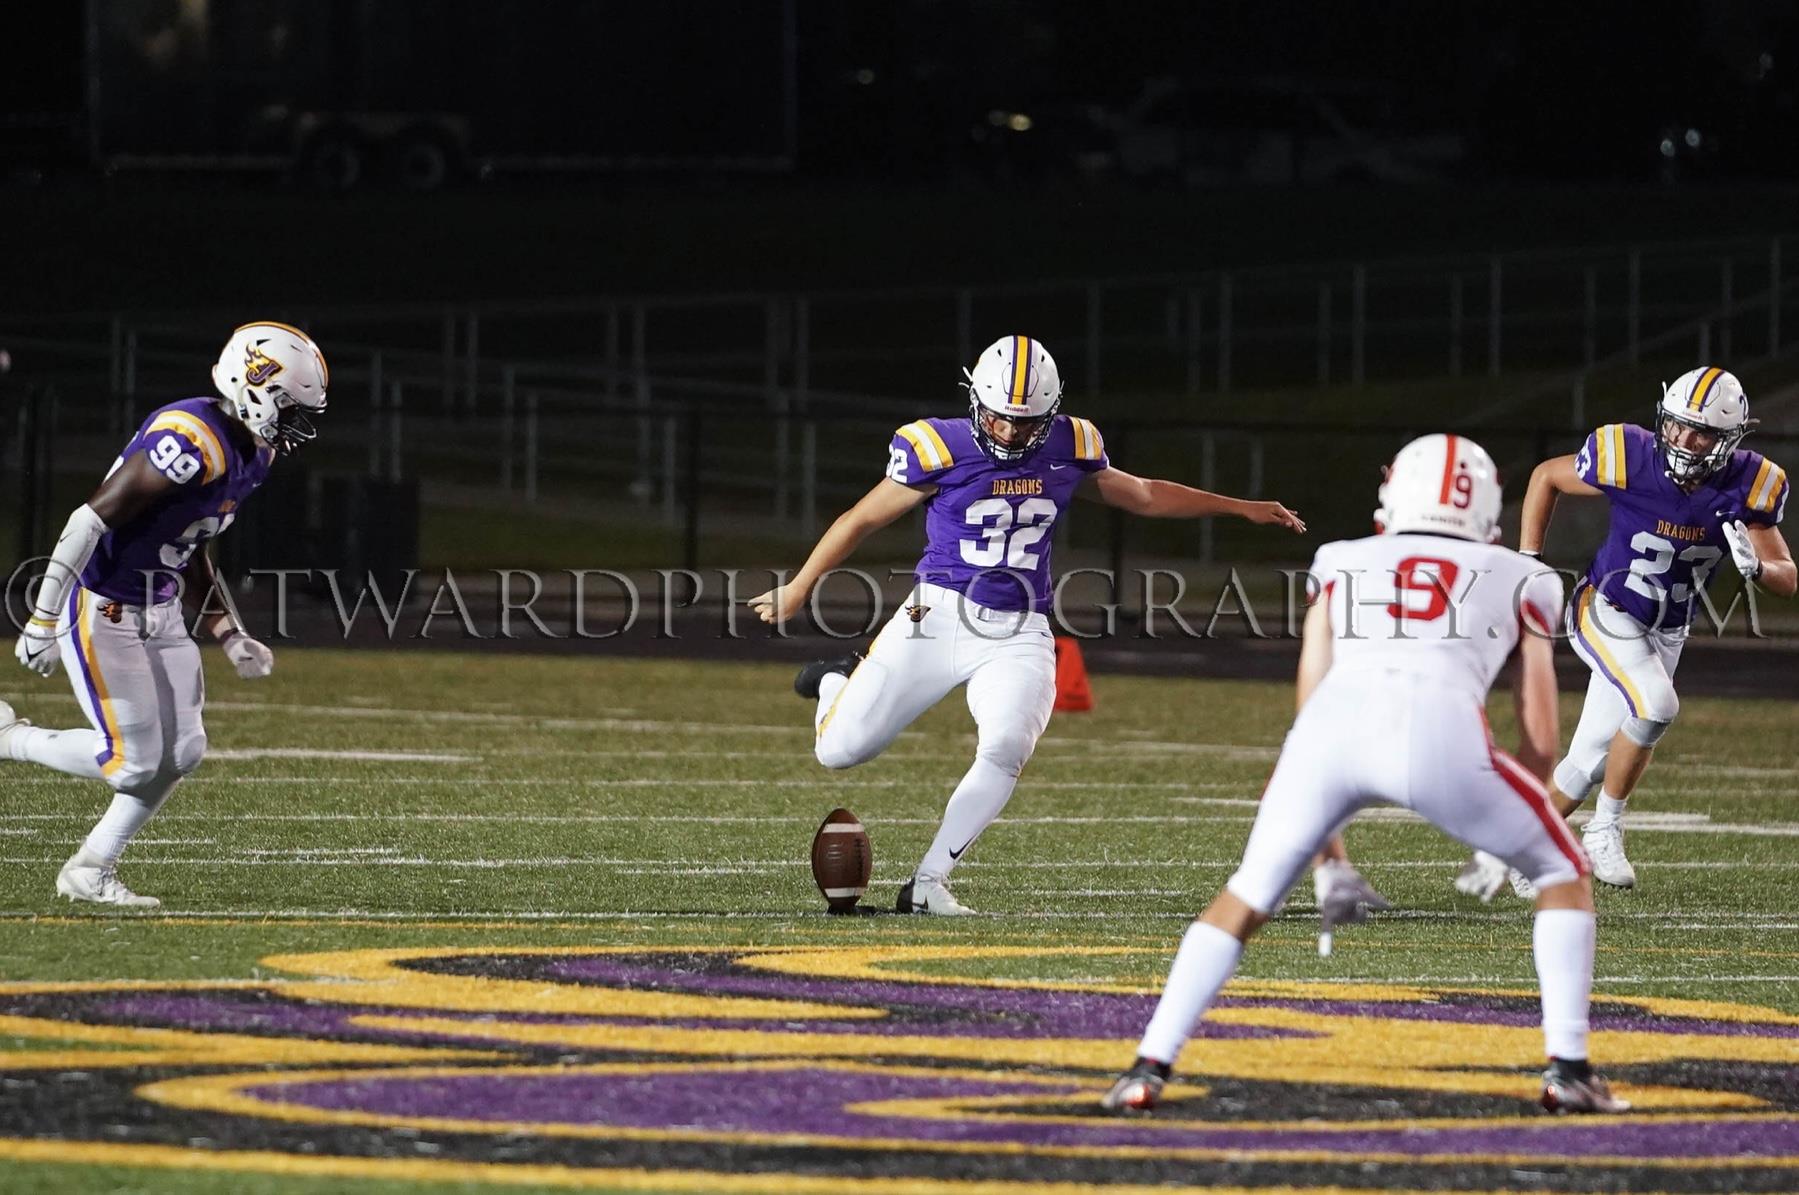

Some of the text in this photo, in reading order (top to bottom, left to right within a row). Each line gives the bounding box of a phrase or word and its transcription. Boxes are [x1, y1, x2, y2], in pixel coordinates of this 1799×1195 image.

[149, 435, 200, 484] 99
[992, 478, 1042, 496] DRAGONS
[1453, 473, 1472, 510] 9
[959, 498, 1058, 571] 32
[1656, 519, 1706, 541] DRAGONS
[1386, 557, 1459, 621] 9
[1624, 530, 1723, 604] 23
